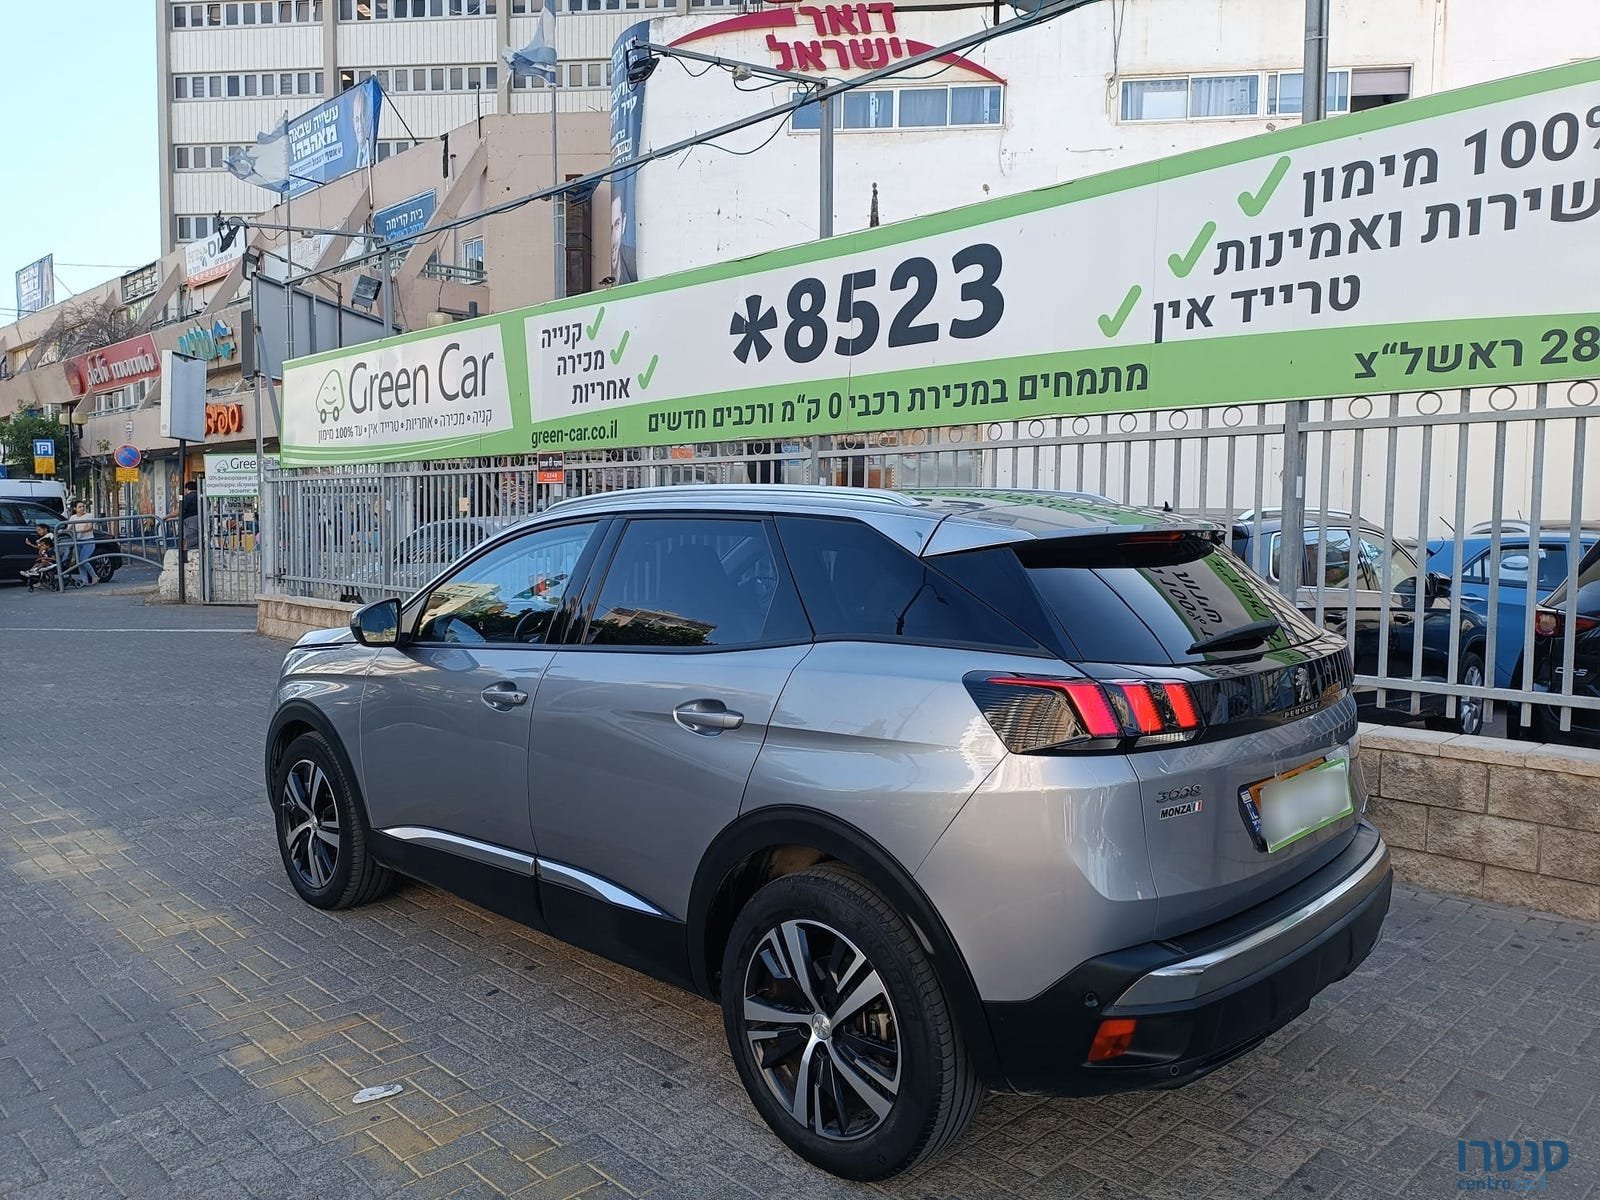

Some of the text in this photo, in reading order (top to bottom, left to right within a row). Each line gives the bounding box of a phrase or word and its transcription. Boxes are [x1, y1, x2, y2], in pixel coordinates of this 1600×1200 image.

[800, 2, 896, 36] דואר
[766, 34, 902, 71] ישראל
[1302, 147, 1438, 217] מימון
[386, 208, 424, 231] בית קדימה
[1212, 178, 1600, 276] שירות ואמינות
[1153, 275, 1361, 344] טרייד אין
[541, 321, 582, 349] קנייה
[1540, 326, 1600, 364] 28
[557, 348, 605, 376] מכירה
[347, 343, 495, 415] Green Car
[572, 377, 631, 405] אחריות
[1018, 363, 1148, 401] מתמחים
[829, 393, 842, 419] 0
[849, 389, 900, 416] רכבי
[907, 379, 1008, 413] במכירת
[380, 421, 399, 433] טרייד
[405, 416, 433, 431] אחריות
[440, 413, 464, 428] מכירה
[472, 409, 493, 427] קניה
[648, 409, 706, 433] חדשים
[712, 403, 774, 427] ורכבים
[318, 428, 334, 444] מימון
[335, 426, 353, 439] 100%
[532, 420, 618, 446] green-car.co.il
[230, 457, 258, 470] Gree
[1284, 702, 1320, 719] PEUGEOT
[1156, 784, 1201, 803] 3008
[1160, 803, 1191, 819] MONZA
